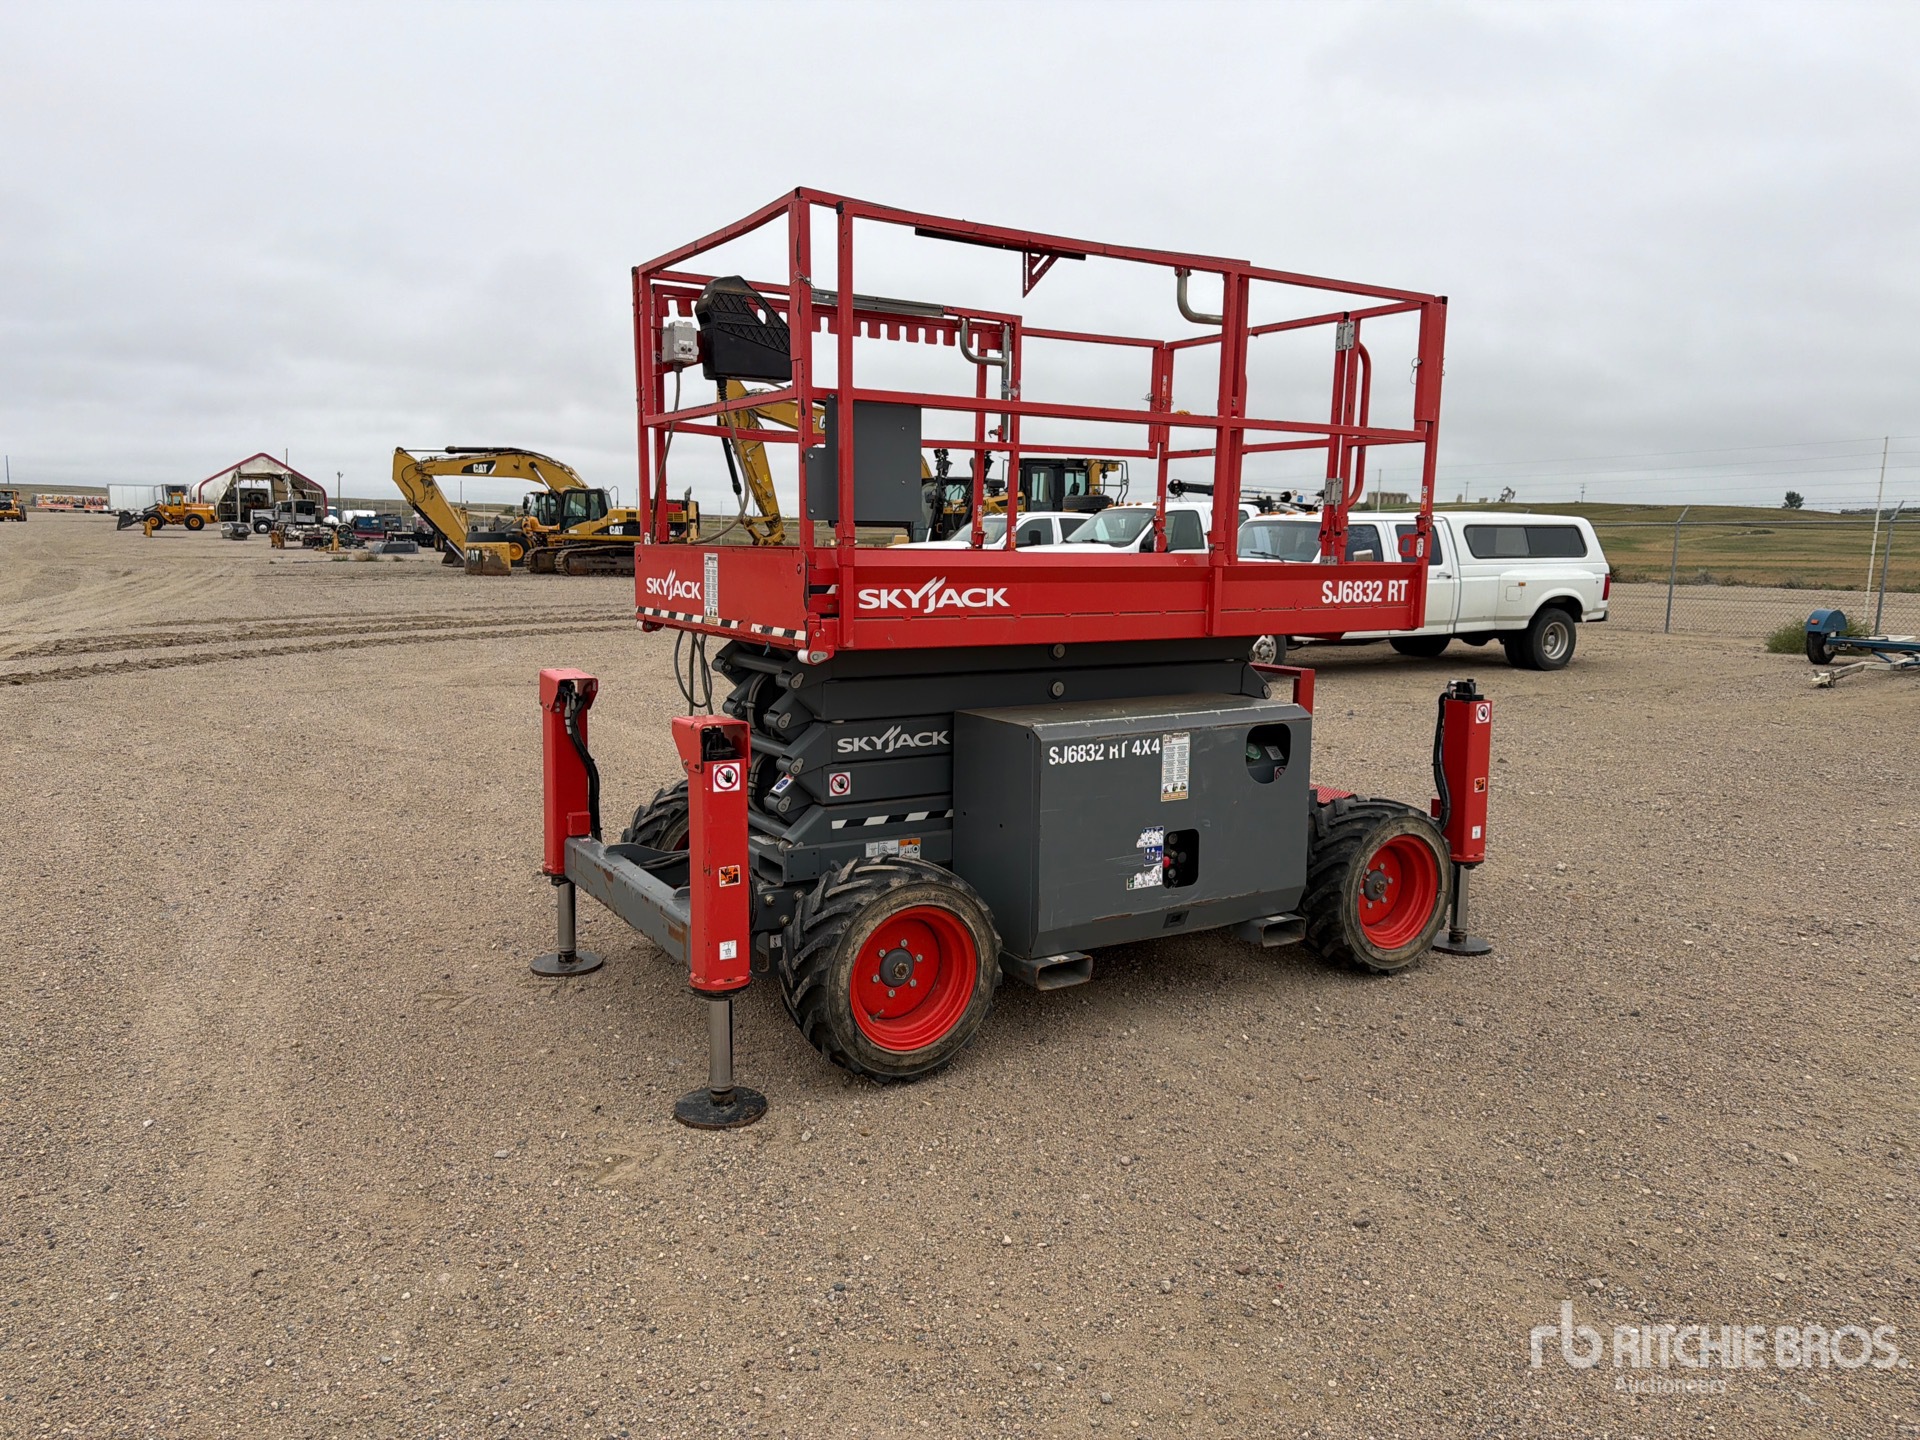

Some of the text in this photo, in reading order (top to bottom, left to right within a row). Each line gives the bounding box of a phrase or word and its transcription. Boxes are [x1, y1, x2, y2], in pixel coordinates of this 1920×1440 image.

[473, 463, 489, 474] CAT
[609, 525, 624, 535] CAT
[646, 569, 702, 601] SKYJACK
[858, 577, 1010, 613] SKYJACK
[1322, 580, 1409, 604] SJ6832 RT
[837, 725, 950, 754] SKYJACK
[1049, 743, 1105, 765] SJ6832
[1131, 738, 1161, 756] 4X4
